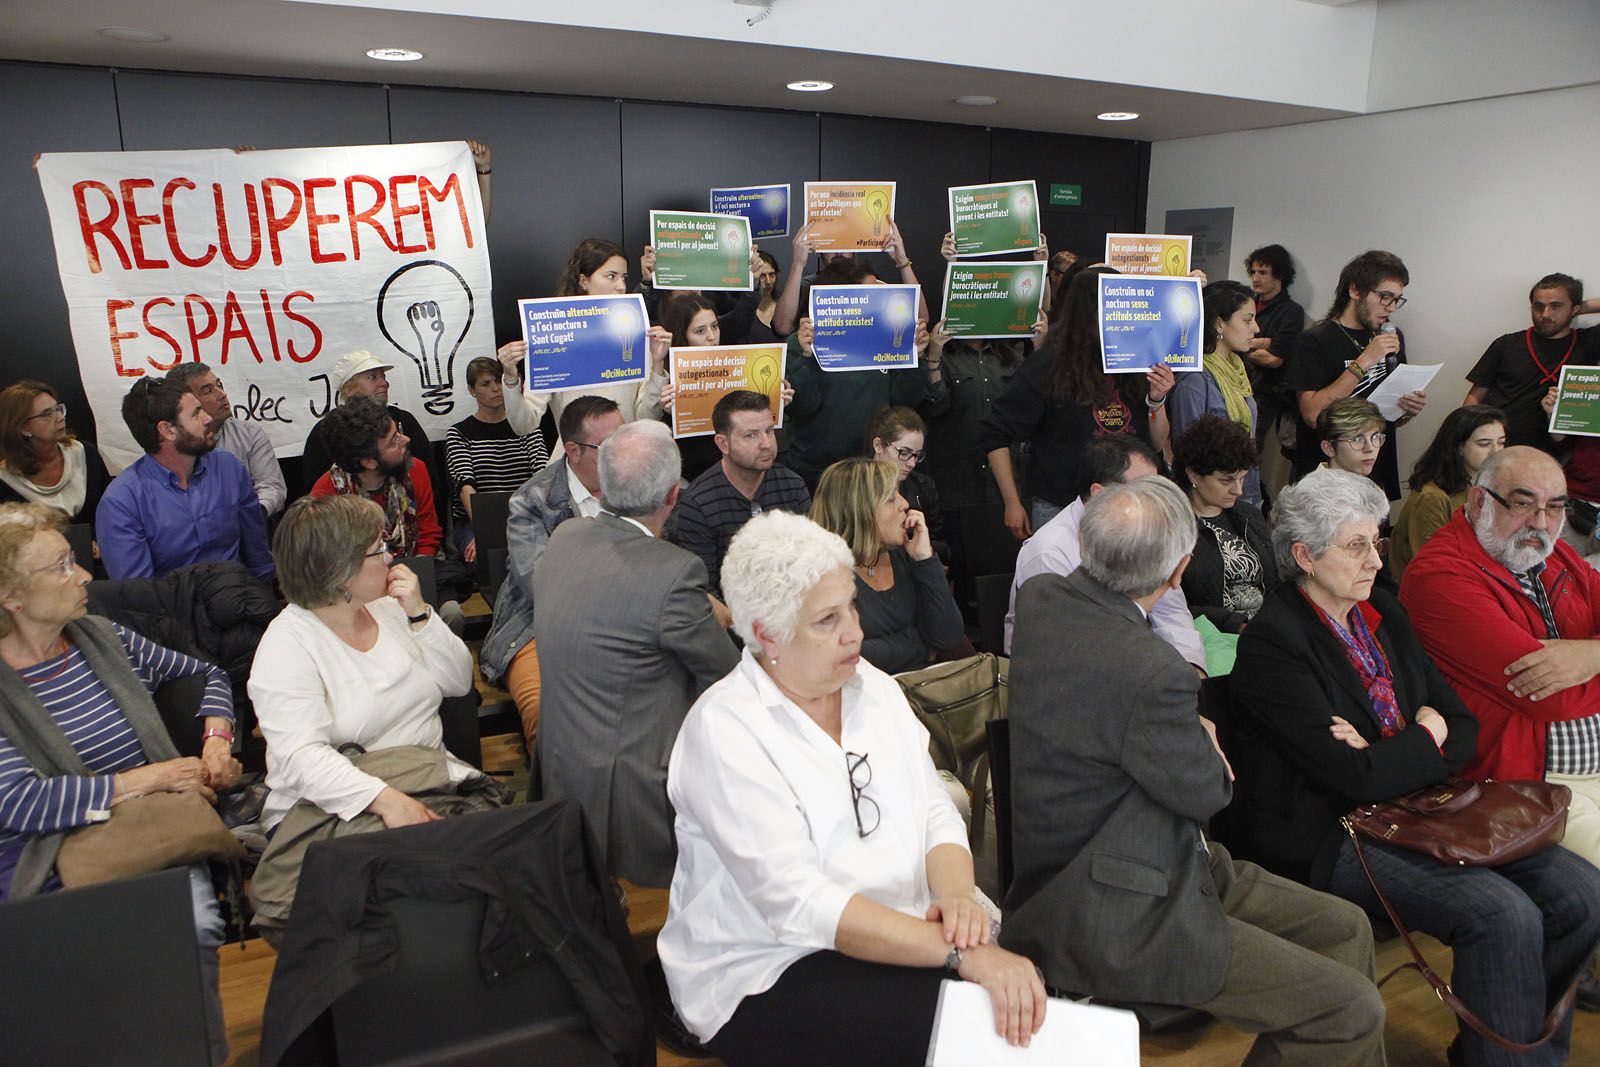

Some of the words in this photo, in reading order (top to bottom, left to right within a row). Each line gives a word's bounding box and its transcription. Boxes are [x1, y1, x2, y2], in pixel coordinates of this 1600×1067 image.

[856, 190, 865, 198] real
[955, 195, 974, 204] Exigim
[956, 214, 973, 224] jovent
[986, 209, 1008, 218] entitats!
[73, 173, 473, 274] RECUPEREM
[657, 220, 667, 228] Per
[669, 221, 687, 230] espais
[688, 221, 695, 229] de
[696, 222, 716, 230] decisió
[657, 240, 676, 250] jovent
[681, 241, 690, 250] per
[698, 242, 718, 251] jovent!
[1112, 243, 1120, 252] Per
[1121, 244, 1137, 253] espais
[1138, 244, 1144, 252] de
[1131, 265, 1139, 274] per
[1144, 264, 1162, 273] jovent!
[953, 271, 973, 281] Exigim
[952, 281, 991, 291] burocràtiques
[949, 291, 970, 301] jovent
[983, 291, 1008, 299] entitats!
[1104, 286, 1136, 297] Construïm
[1137, 288, 1145, 296] un
[1146, 287, 1154, 297] oci
[816, 296, 849, 305] Construïm
[860, 295, 868, 304] oci
[1105, 299, 1130, 309] nocturn
[1131, 301, 1149, 309] sense
[529, 309, 566, 320] Construïm
[567, 306, 609, 318] alternatives
[817, 307, 842, 316] nocturn
[1105, 311, 1132, 321] actituds
[1133, 311, 1161, 321] sexistes!
[554, 321, 582, 331] nocturn
[818, 318, 844, 327] actituds
[845, 317, 874, 326] sexistes!
[107, 289, 323, 376] ESPAIS
[532, 335, 549, 345] Sant
[550, 332, 574, 345] Cugat!
[678, 358, 690, 368] Per
[691, 357, 713, 368] espais
[714, 357, 722, 366] de
[724, 356, 746, 366] decisió
[874, 353, 910, 362] #OciNocturn
[601, 367, 642, 378] #OciNocturn
[679, 369, 732, 380] autogestionats,
[733, 368, 742, 377] del
[1578, 374, 1599, 383] espais
[678, 382, 701, 392] jovent
[705, 381, 716, 391] per
[717, 380, 723, 388] al
[724, 379, 747, 390] jovent!
[1561, 390, 1584, 400] jovent
[234, 384, 292, 423] plec
